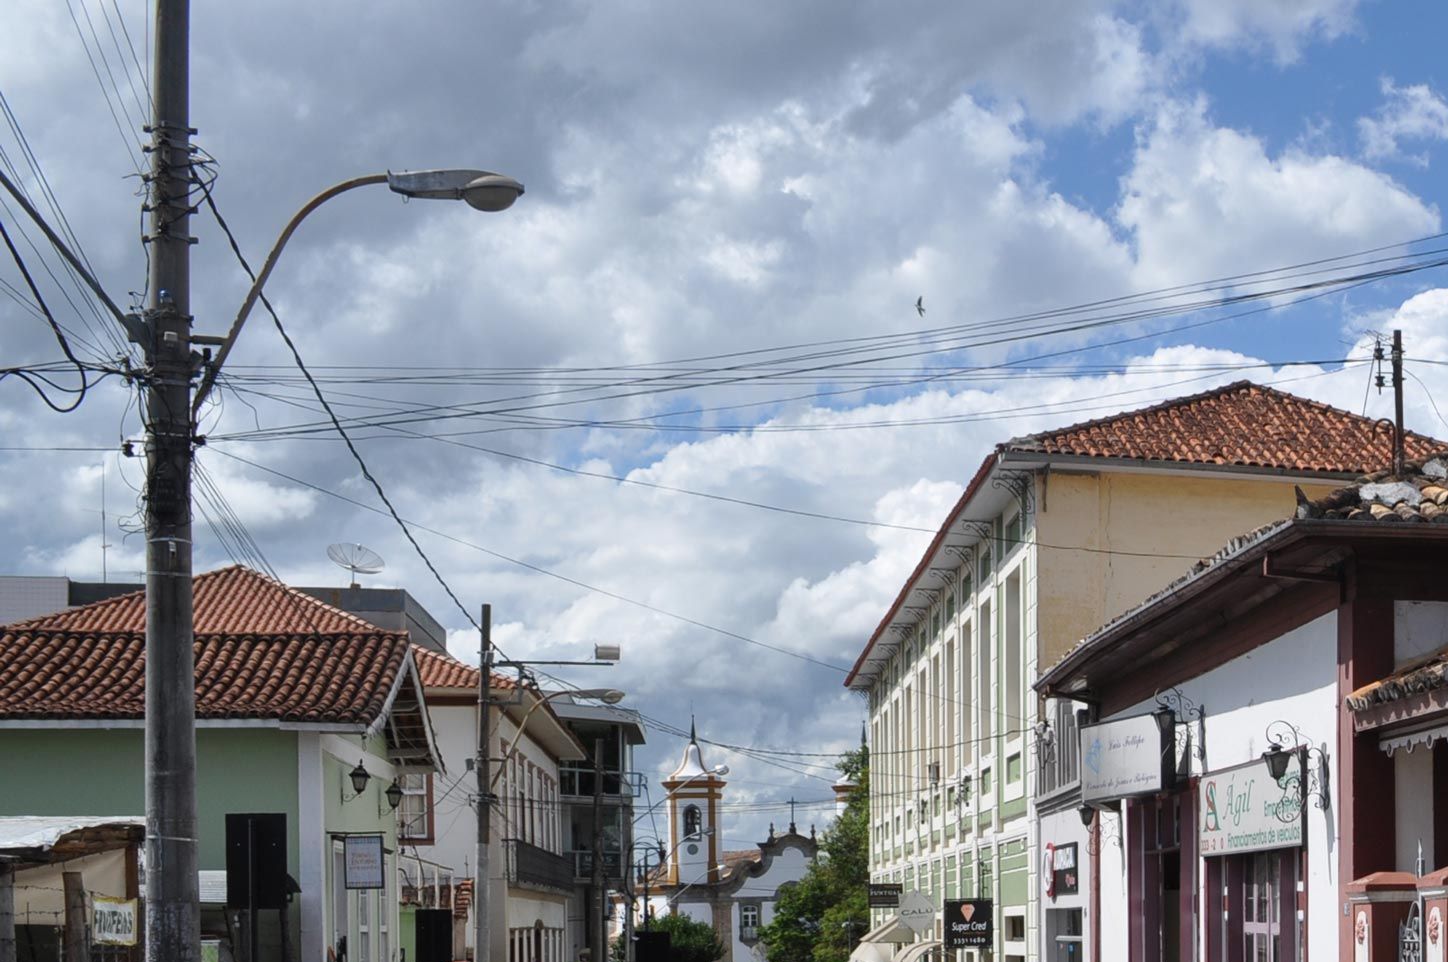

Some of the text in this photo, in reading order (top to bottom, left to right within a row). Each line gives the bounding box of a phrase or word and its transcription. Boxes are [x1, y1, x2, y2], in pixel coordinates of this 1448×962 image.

[1223, 773, 1255, 827] Ágil
[1227, 828, 1267, 848] Financiamentos
[952, 921, 987, 932] Super Cred
